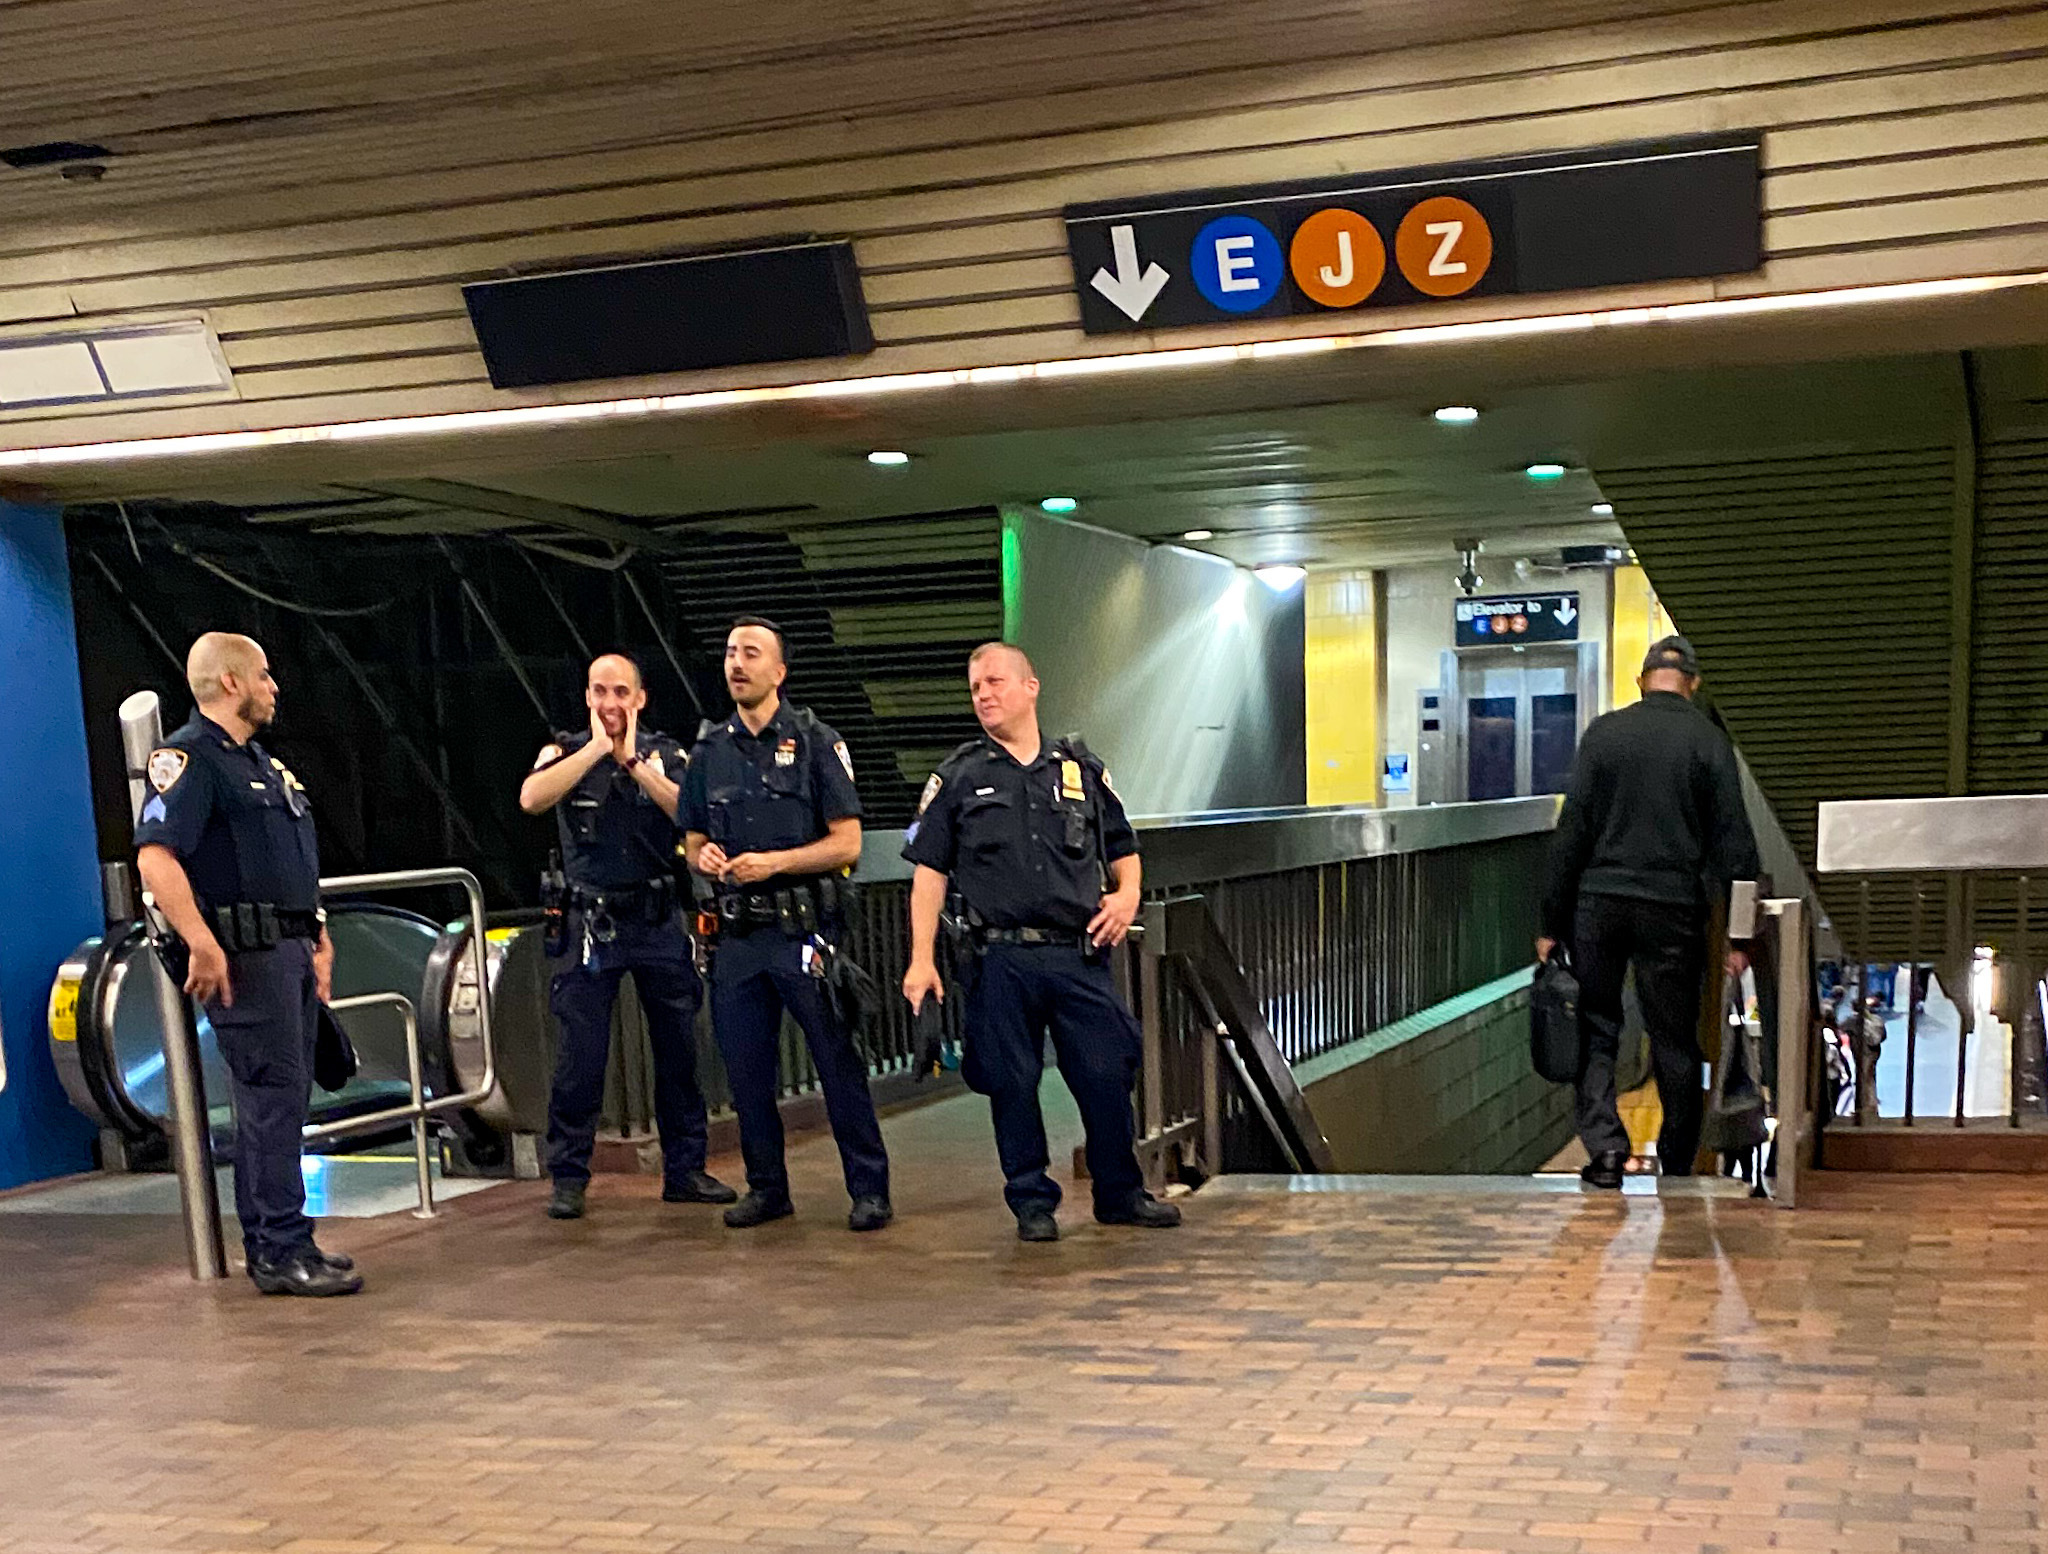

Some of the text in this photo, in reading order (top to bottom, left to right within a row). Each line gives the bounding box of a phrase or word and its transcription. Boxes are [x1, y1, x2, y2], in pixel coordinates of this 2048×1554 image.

[1215, 220, 1468, 292] E J Z
